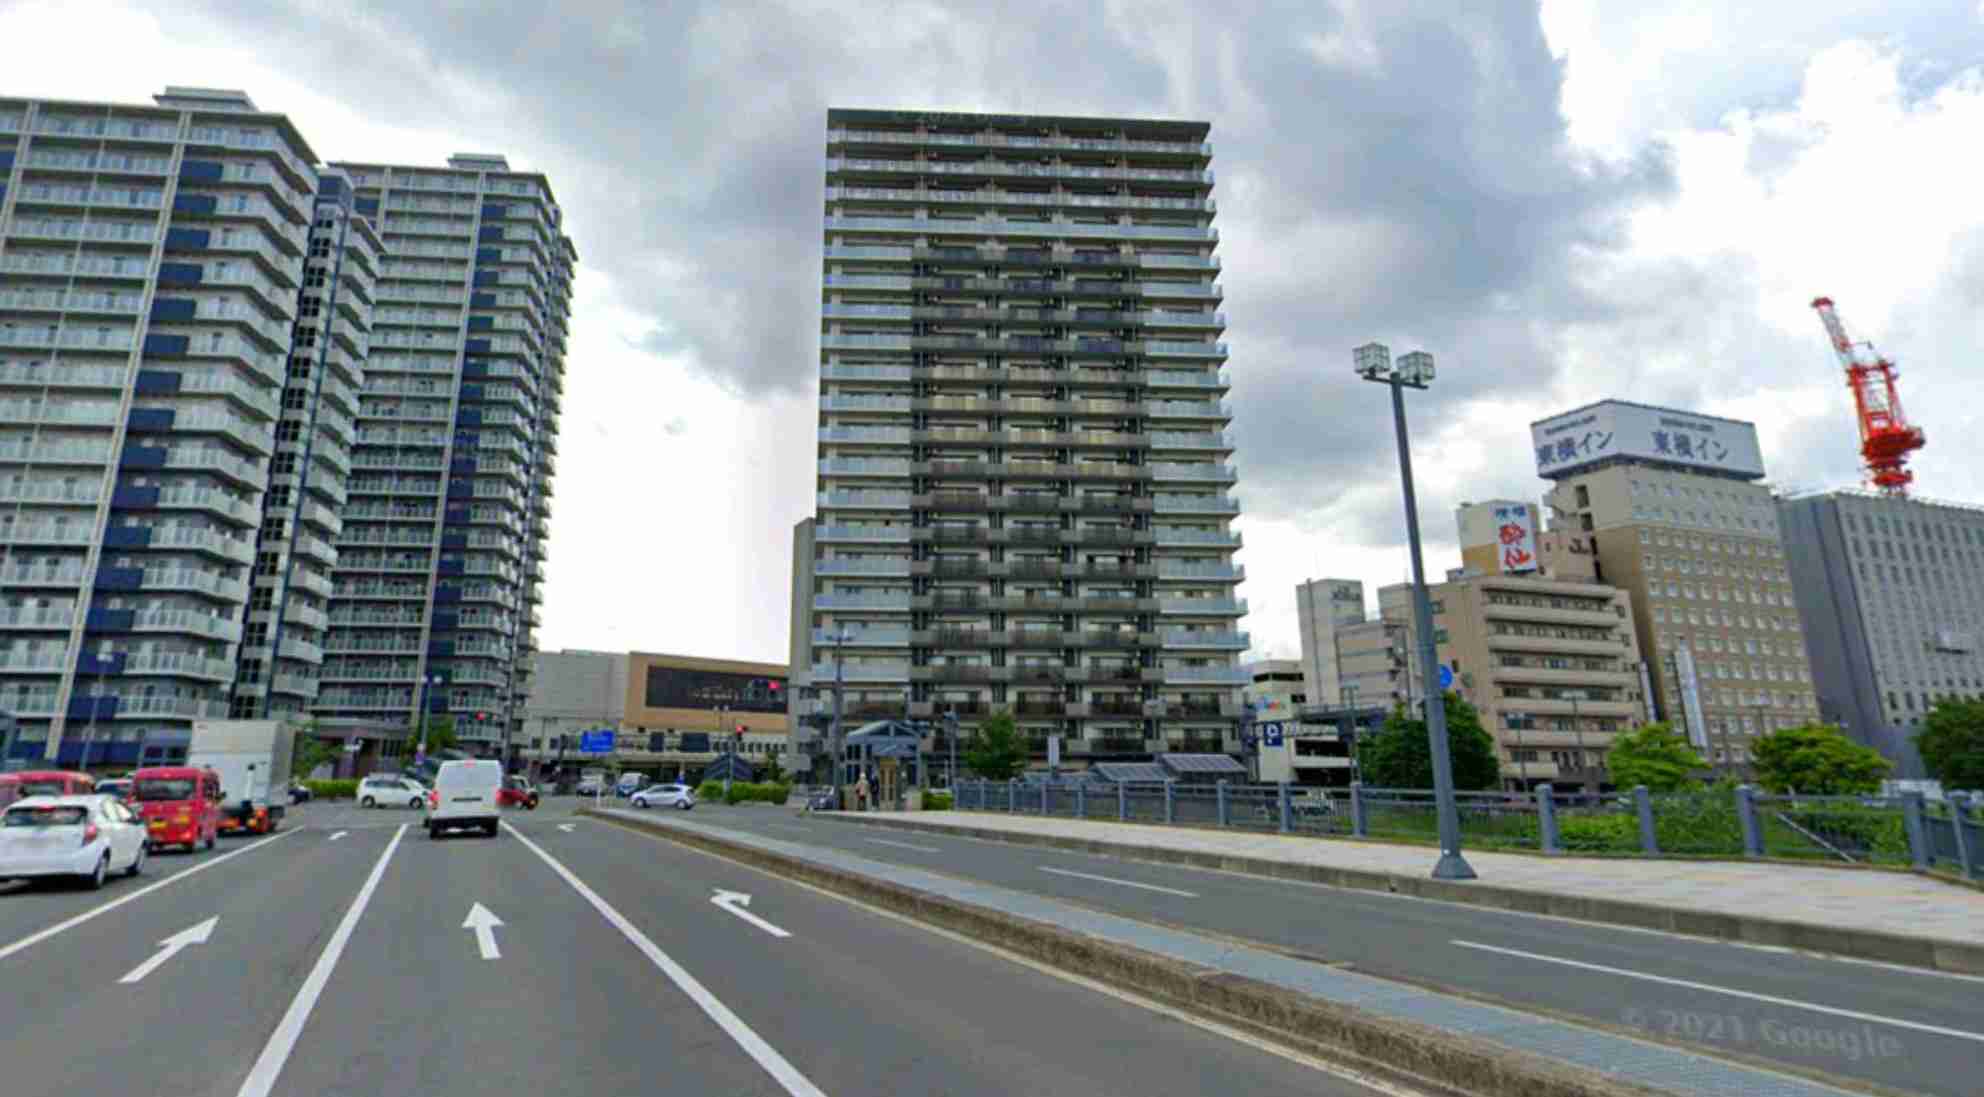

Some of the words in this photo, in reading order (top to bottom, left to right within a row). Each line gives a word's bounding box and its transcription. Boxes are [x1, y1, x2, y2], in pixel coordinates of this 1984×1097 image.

[1537, 430, 1613, 466] 東横イン
[1652, 429, 1728, 462] 東横イン
